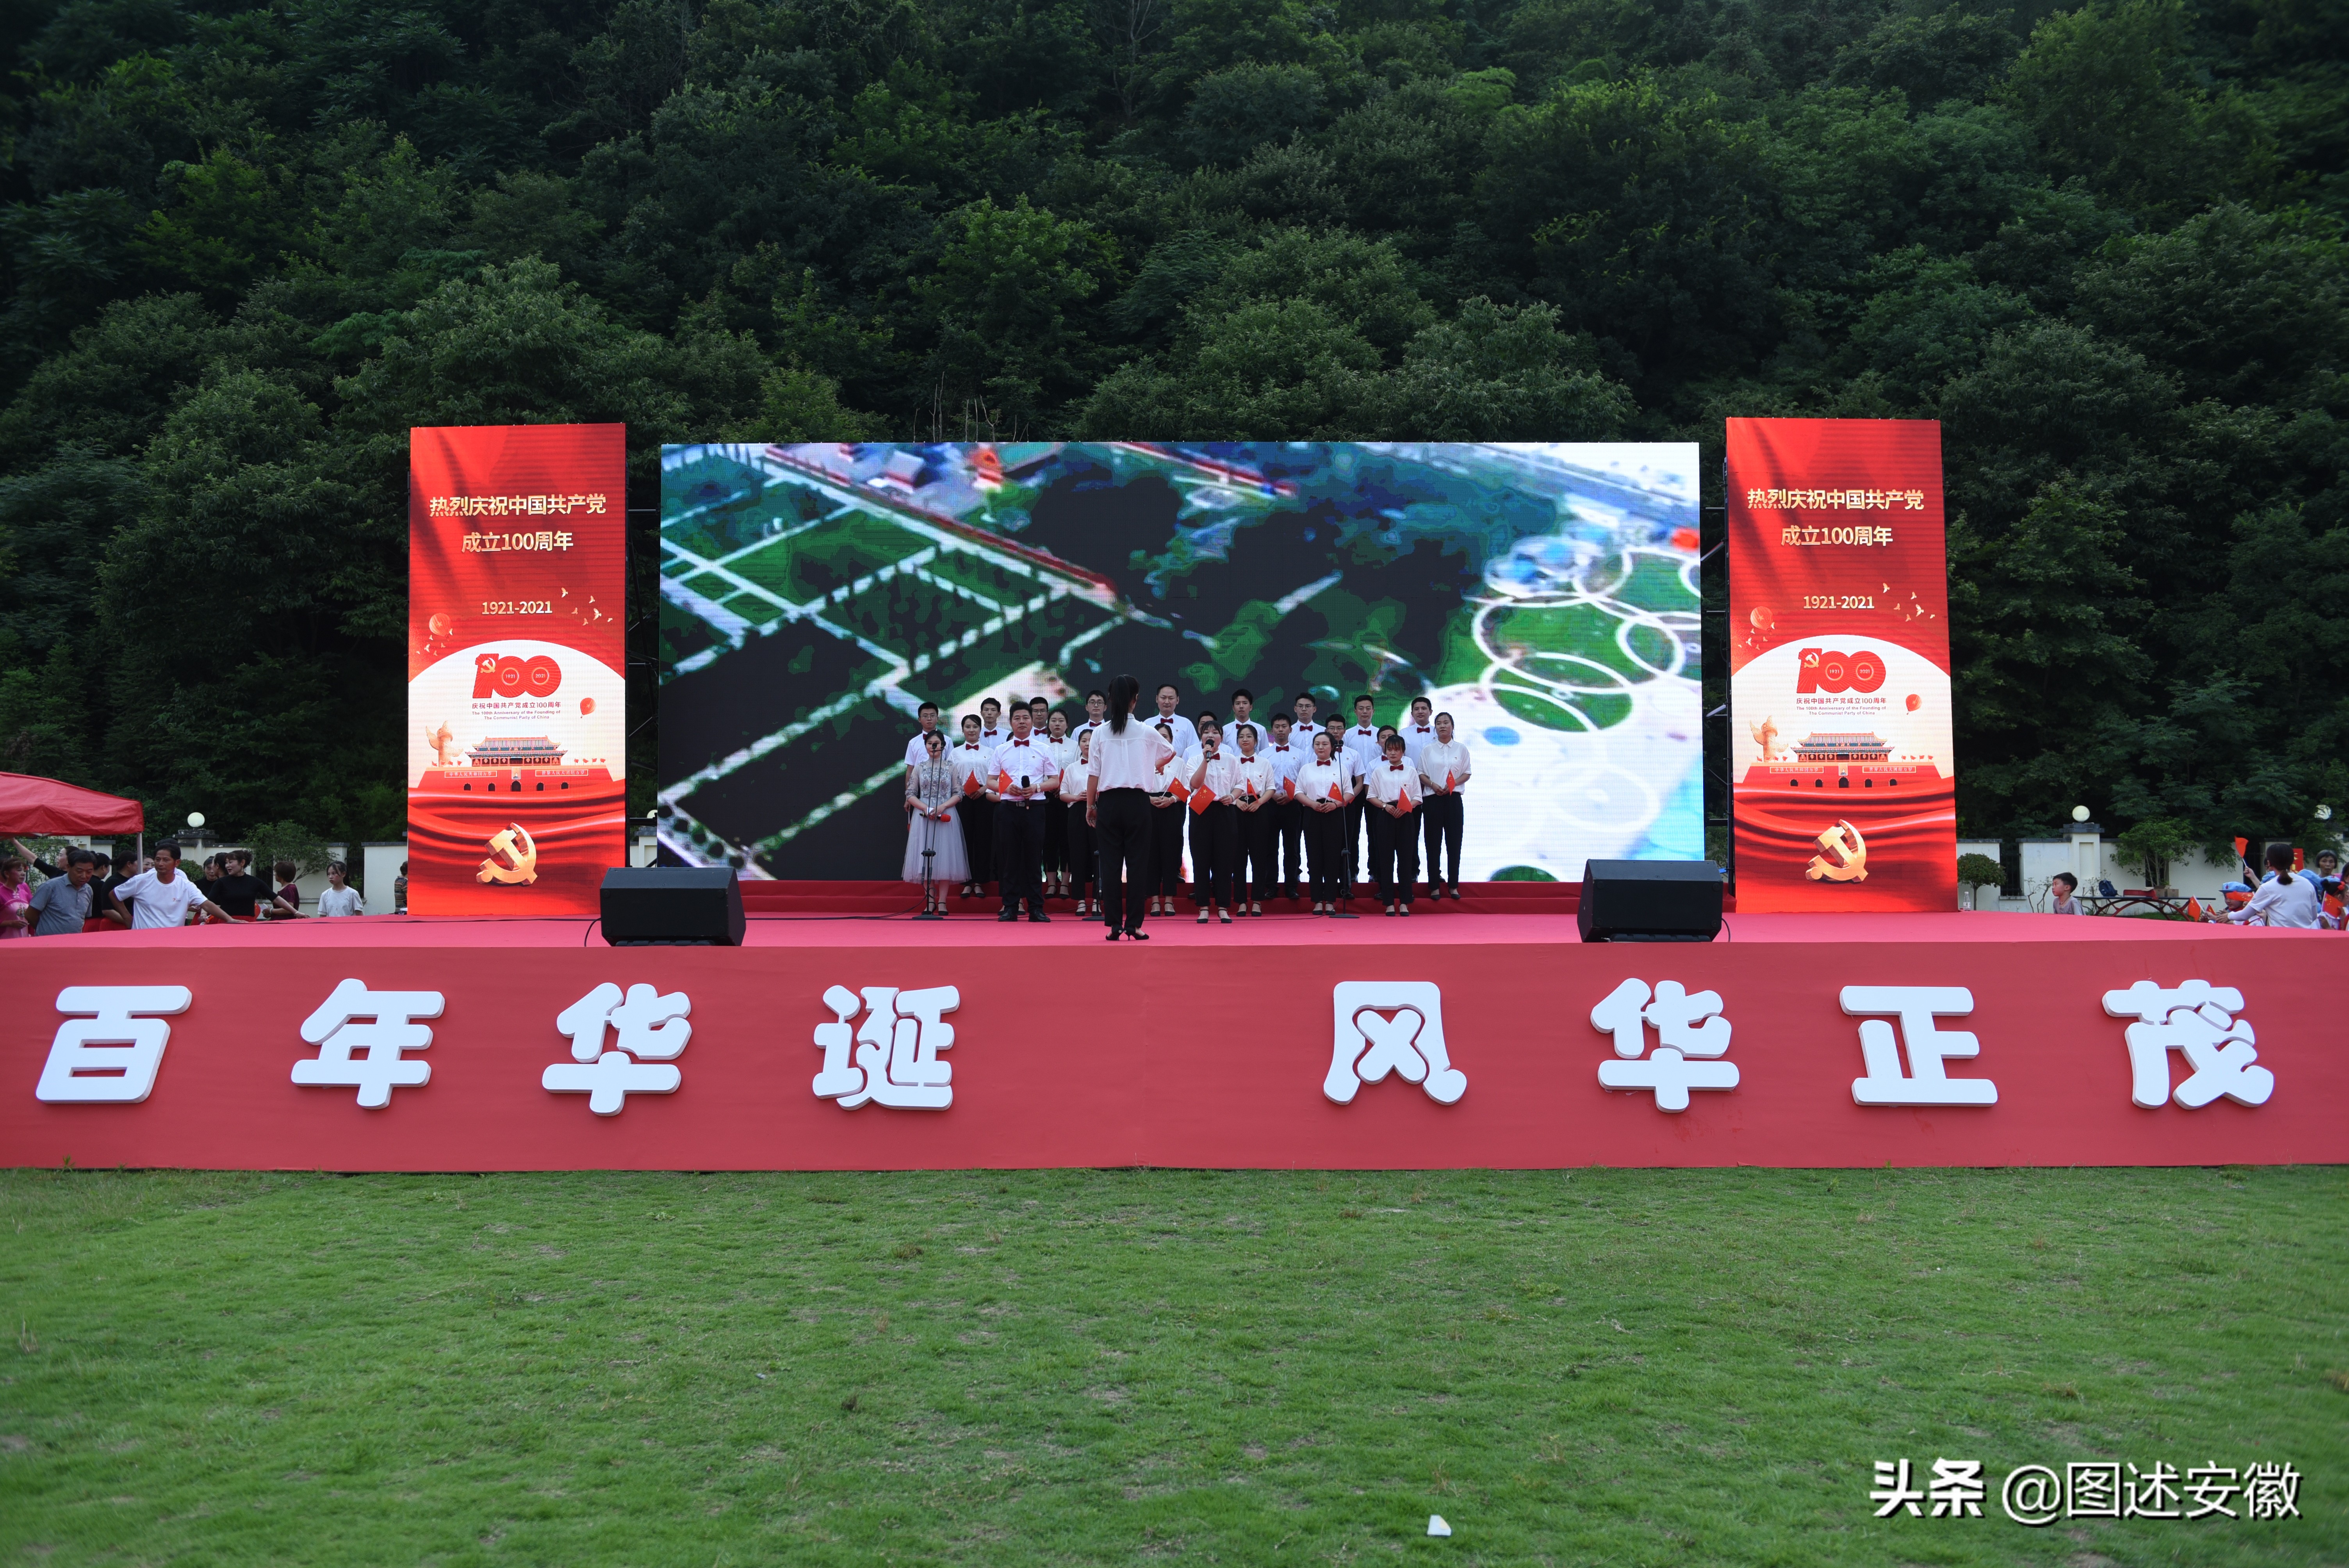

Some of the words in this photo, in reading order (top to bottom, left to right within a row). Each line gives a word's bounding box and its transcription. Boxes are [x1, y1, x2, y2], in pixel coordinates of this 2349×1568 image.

[430, 494, 606, 517] 热烈庆祝中国共产党
[1747, 488, 1924, 510] 热烈庆祝中国共产党
[462, 531, 573, 552] 成立100周年
[1781, 525, 1893, 546] 成立100周年
[482, 601, 552, 614] 1921-2021
[1803, 595, 1875, 609] 1921-2021
[36, 978, 960, 1116] 百年华诞
[1323, 978, 2274, 1113] 风华正茂
